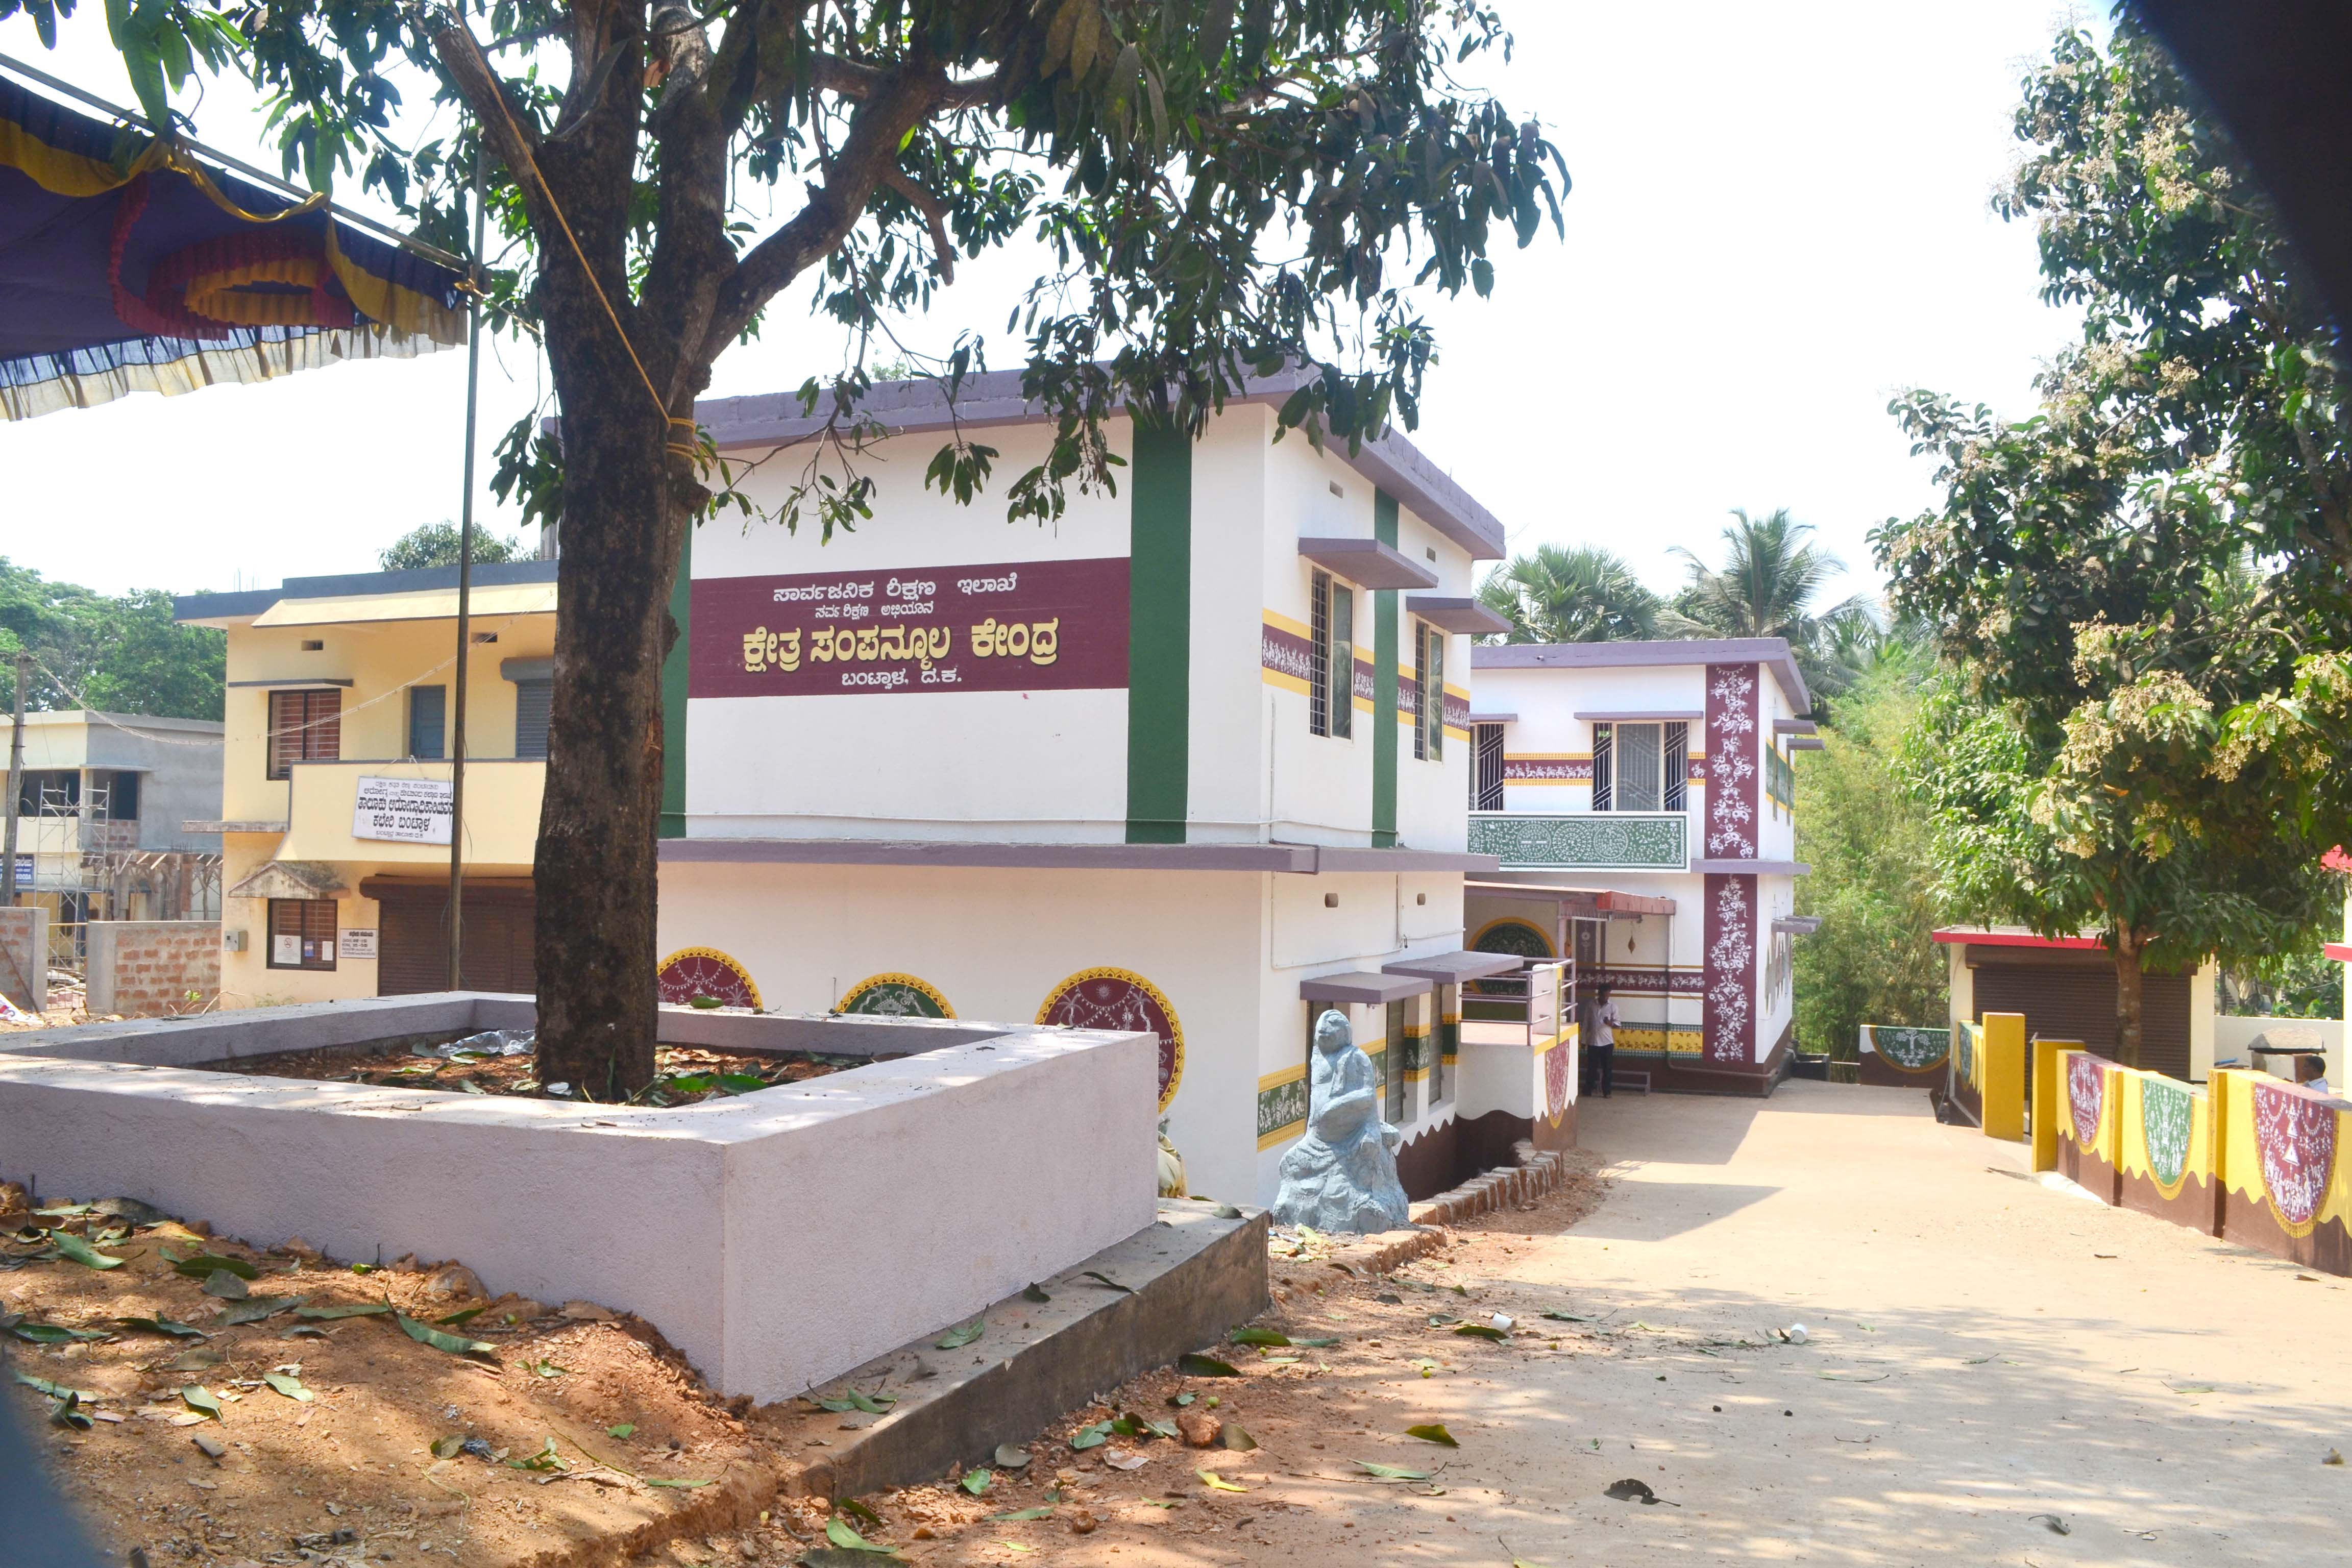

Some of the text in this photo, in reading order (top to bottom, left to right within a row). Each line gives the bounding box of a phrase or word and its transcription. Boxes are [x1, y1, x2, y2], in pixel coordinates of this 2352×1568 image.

[773, 572, 1017, 602] ಸಾರ್ವಜನಿಕ ಶಿಕ್ಷಣ ಇಲಾಖೆ
[815, 601, 934, 620] ಸರ್ವ ಶಿಕ್ಷಣ ಅಭಿಯಾನ
[743, 618, 1059, 672] ಕ್ಷೇತ್ರ ಸಂಪನ್ಮೂಲ ಕೇಂದ್ರ
[842, 668, 962, 689] ಬಂಟ್ವಾಳ, ದ.ಕ.
